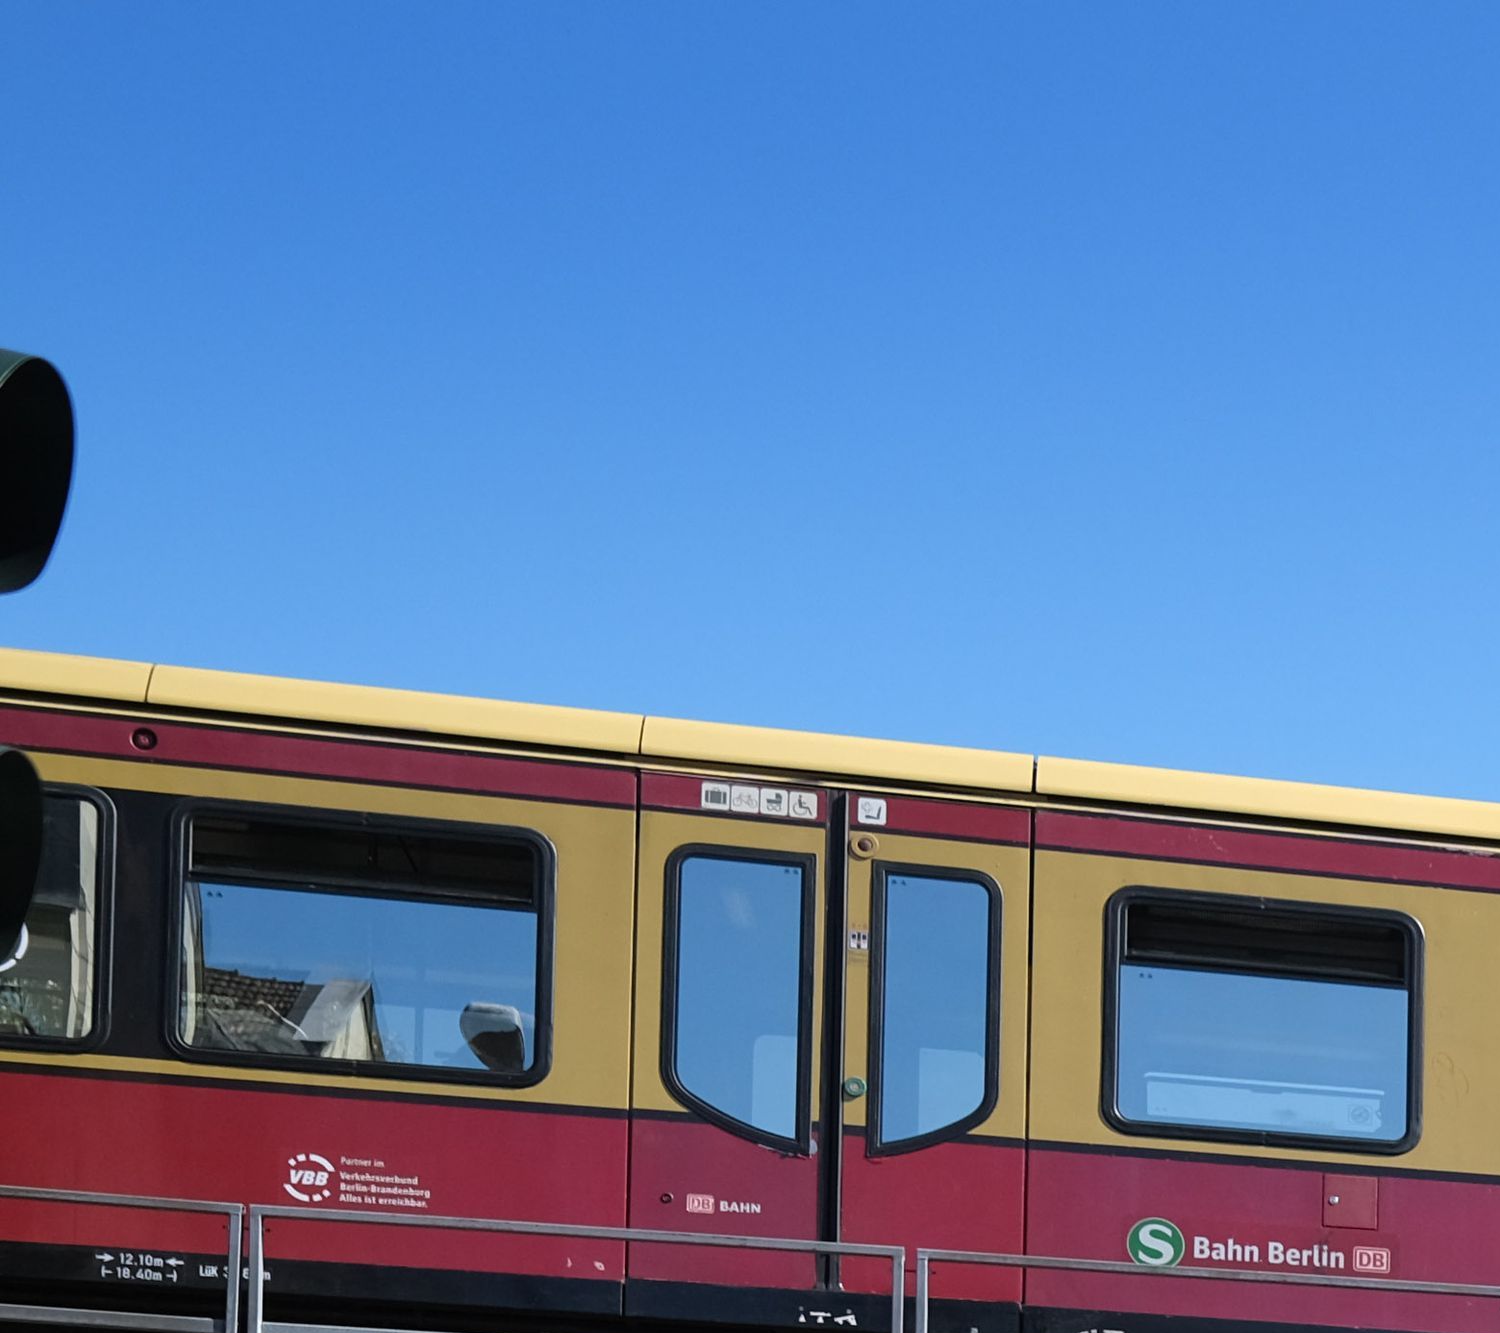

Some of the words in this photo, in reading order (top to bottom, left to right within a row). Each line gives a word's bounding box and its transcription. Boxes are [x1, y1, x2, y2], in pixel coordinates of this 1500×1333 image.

[289, 1169, 329, 1186] VBB
[340, 1171, 419, 1185] Verkehrsverbund
[340, 1182, 431, 1199] Berlin-Brandenburg
[340, 1193, 363, 1204] Alles
[687, 1194, 714, 1213] DB
[719, 1200, 761, 1214] BAHN
[1137, 1223, 1175, 1267] S
[1193, 1236, 1260, 1263] Bahn
[1267, 1241, 1345, 1270] Berlin
[1357, 1250, 1386, 1271] DB
[119, 1252, 164, 1268] 12.10m
[116, 1266, 163, 1282] 18.40m
